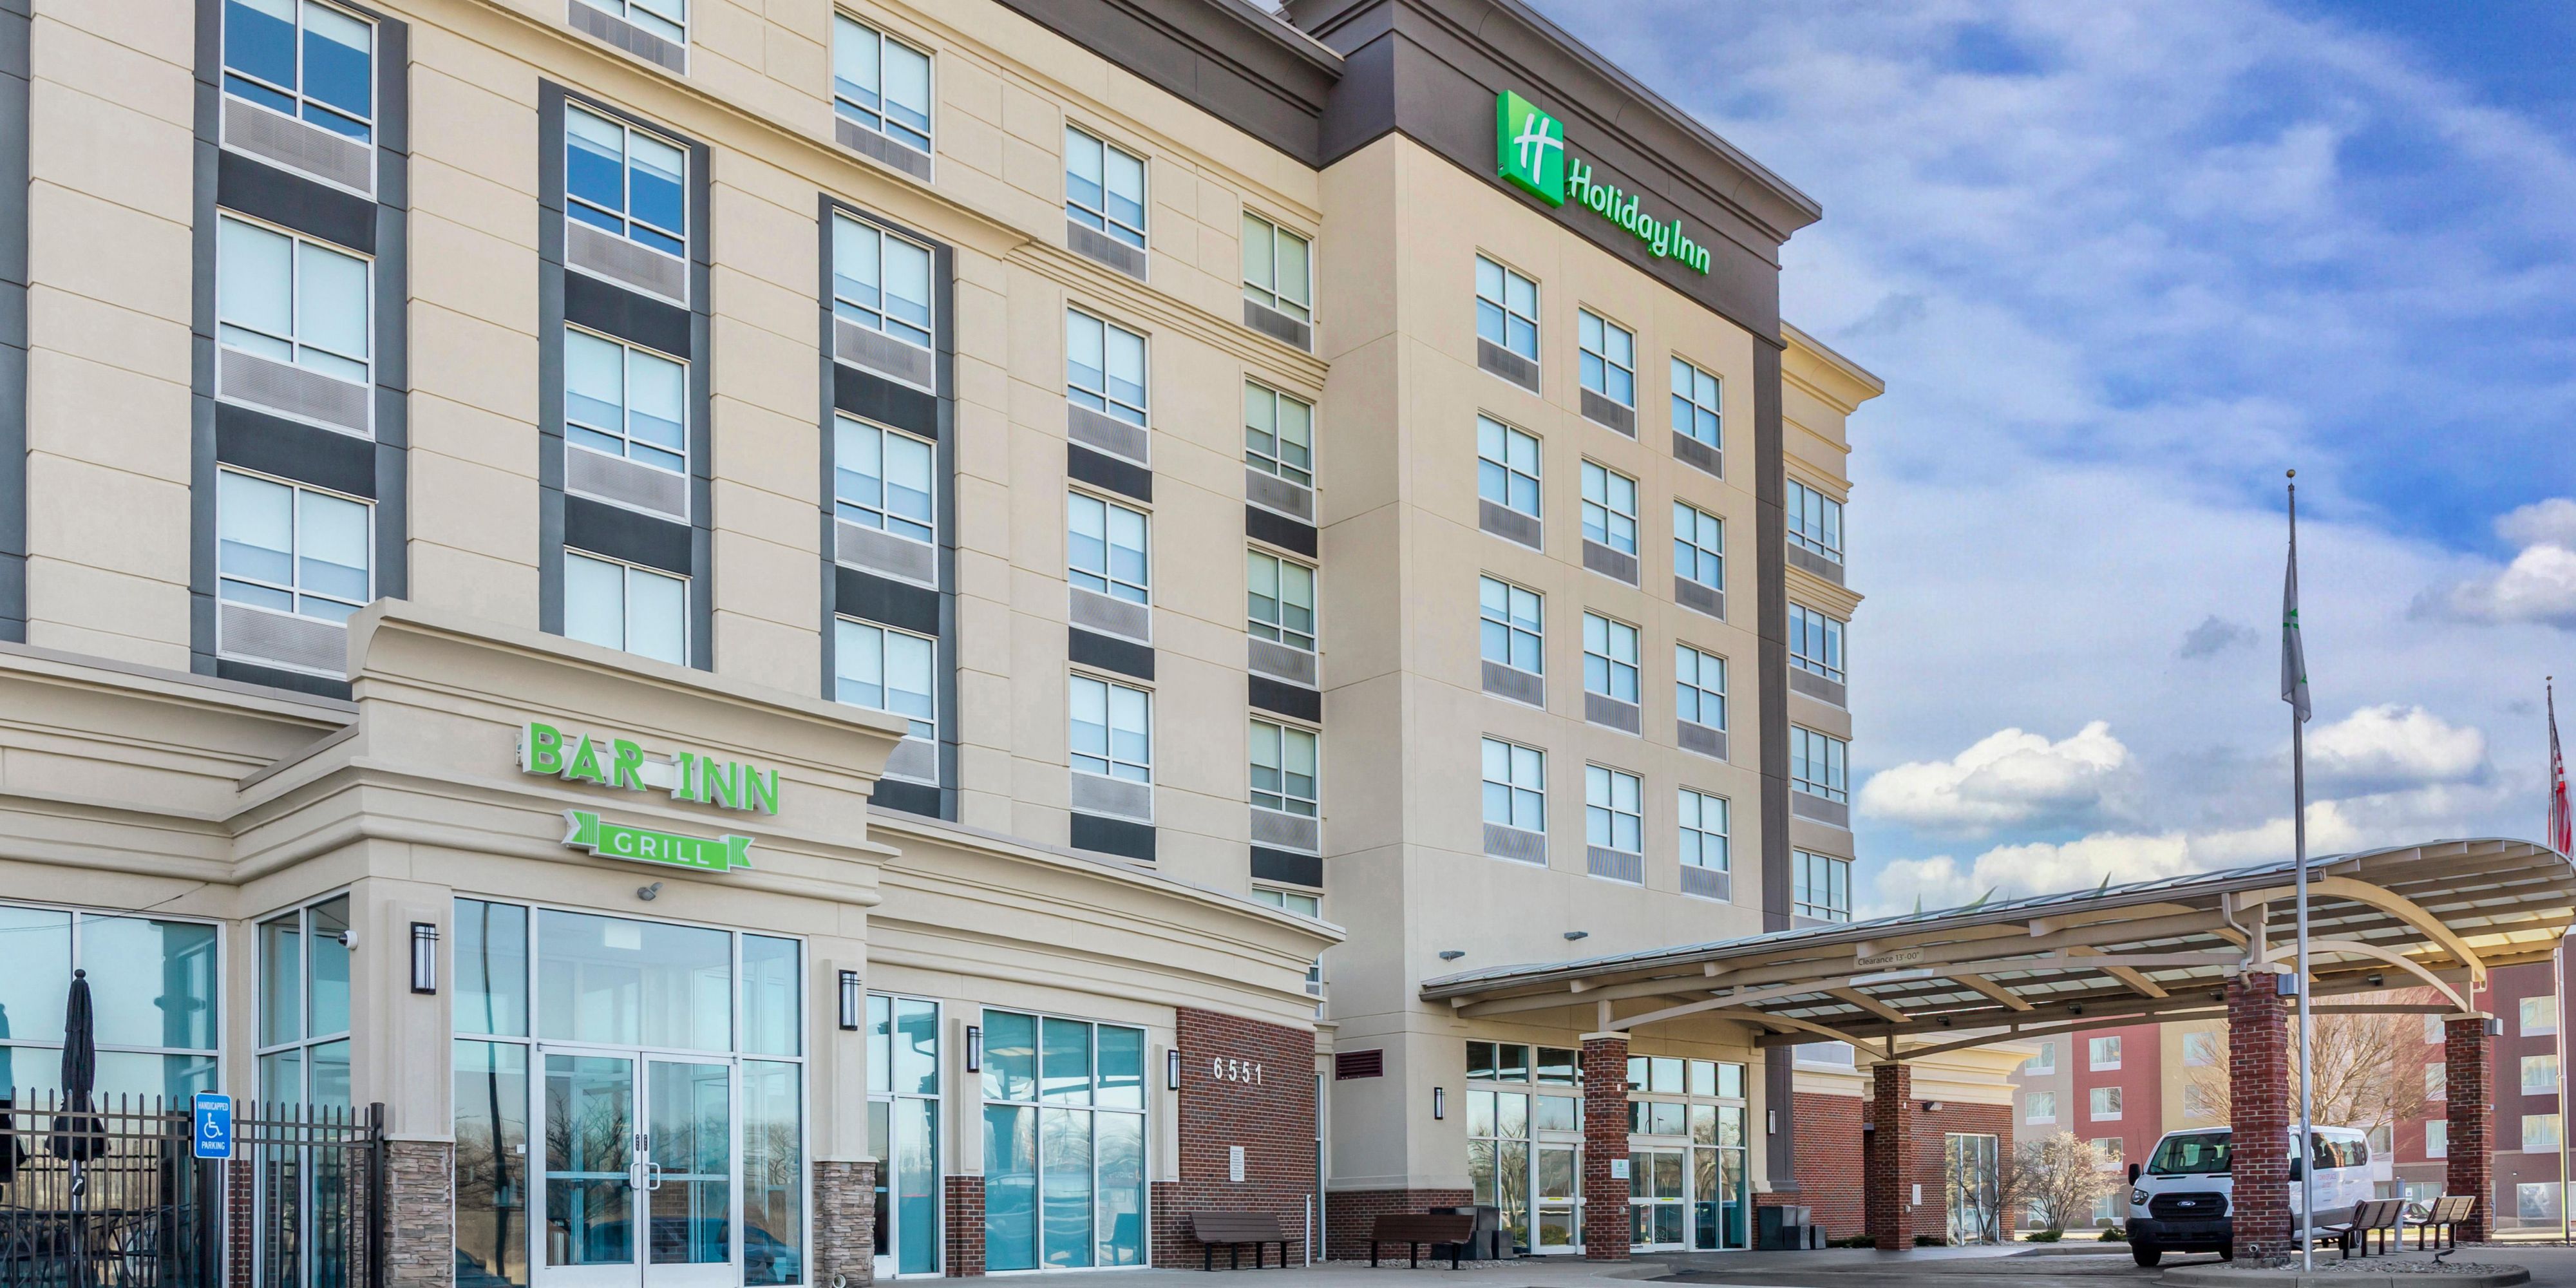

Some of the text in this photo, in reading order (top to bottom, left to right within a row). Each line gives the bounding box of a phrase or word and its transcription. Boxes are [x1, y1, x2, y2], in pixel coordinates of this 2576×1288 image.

[1567, 158, 1710, 275] Holiday Inn
[524, 721, 779, 816] BAR INN
[613, 831, 710, 865] GRILL
[1858, 956, 1894, 966] Clearance
[1213, 1056, 1261, 1085] 6551
[198, 1101, 229, 1111] HANDICAPPED
[201, 1141, 225, 1150] PARKING
